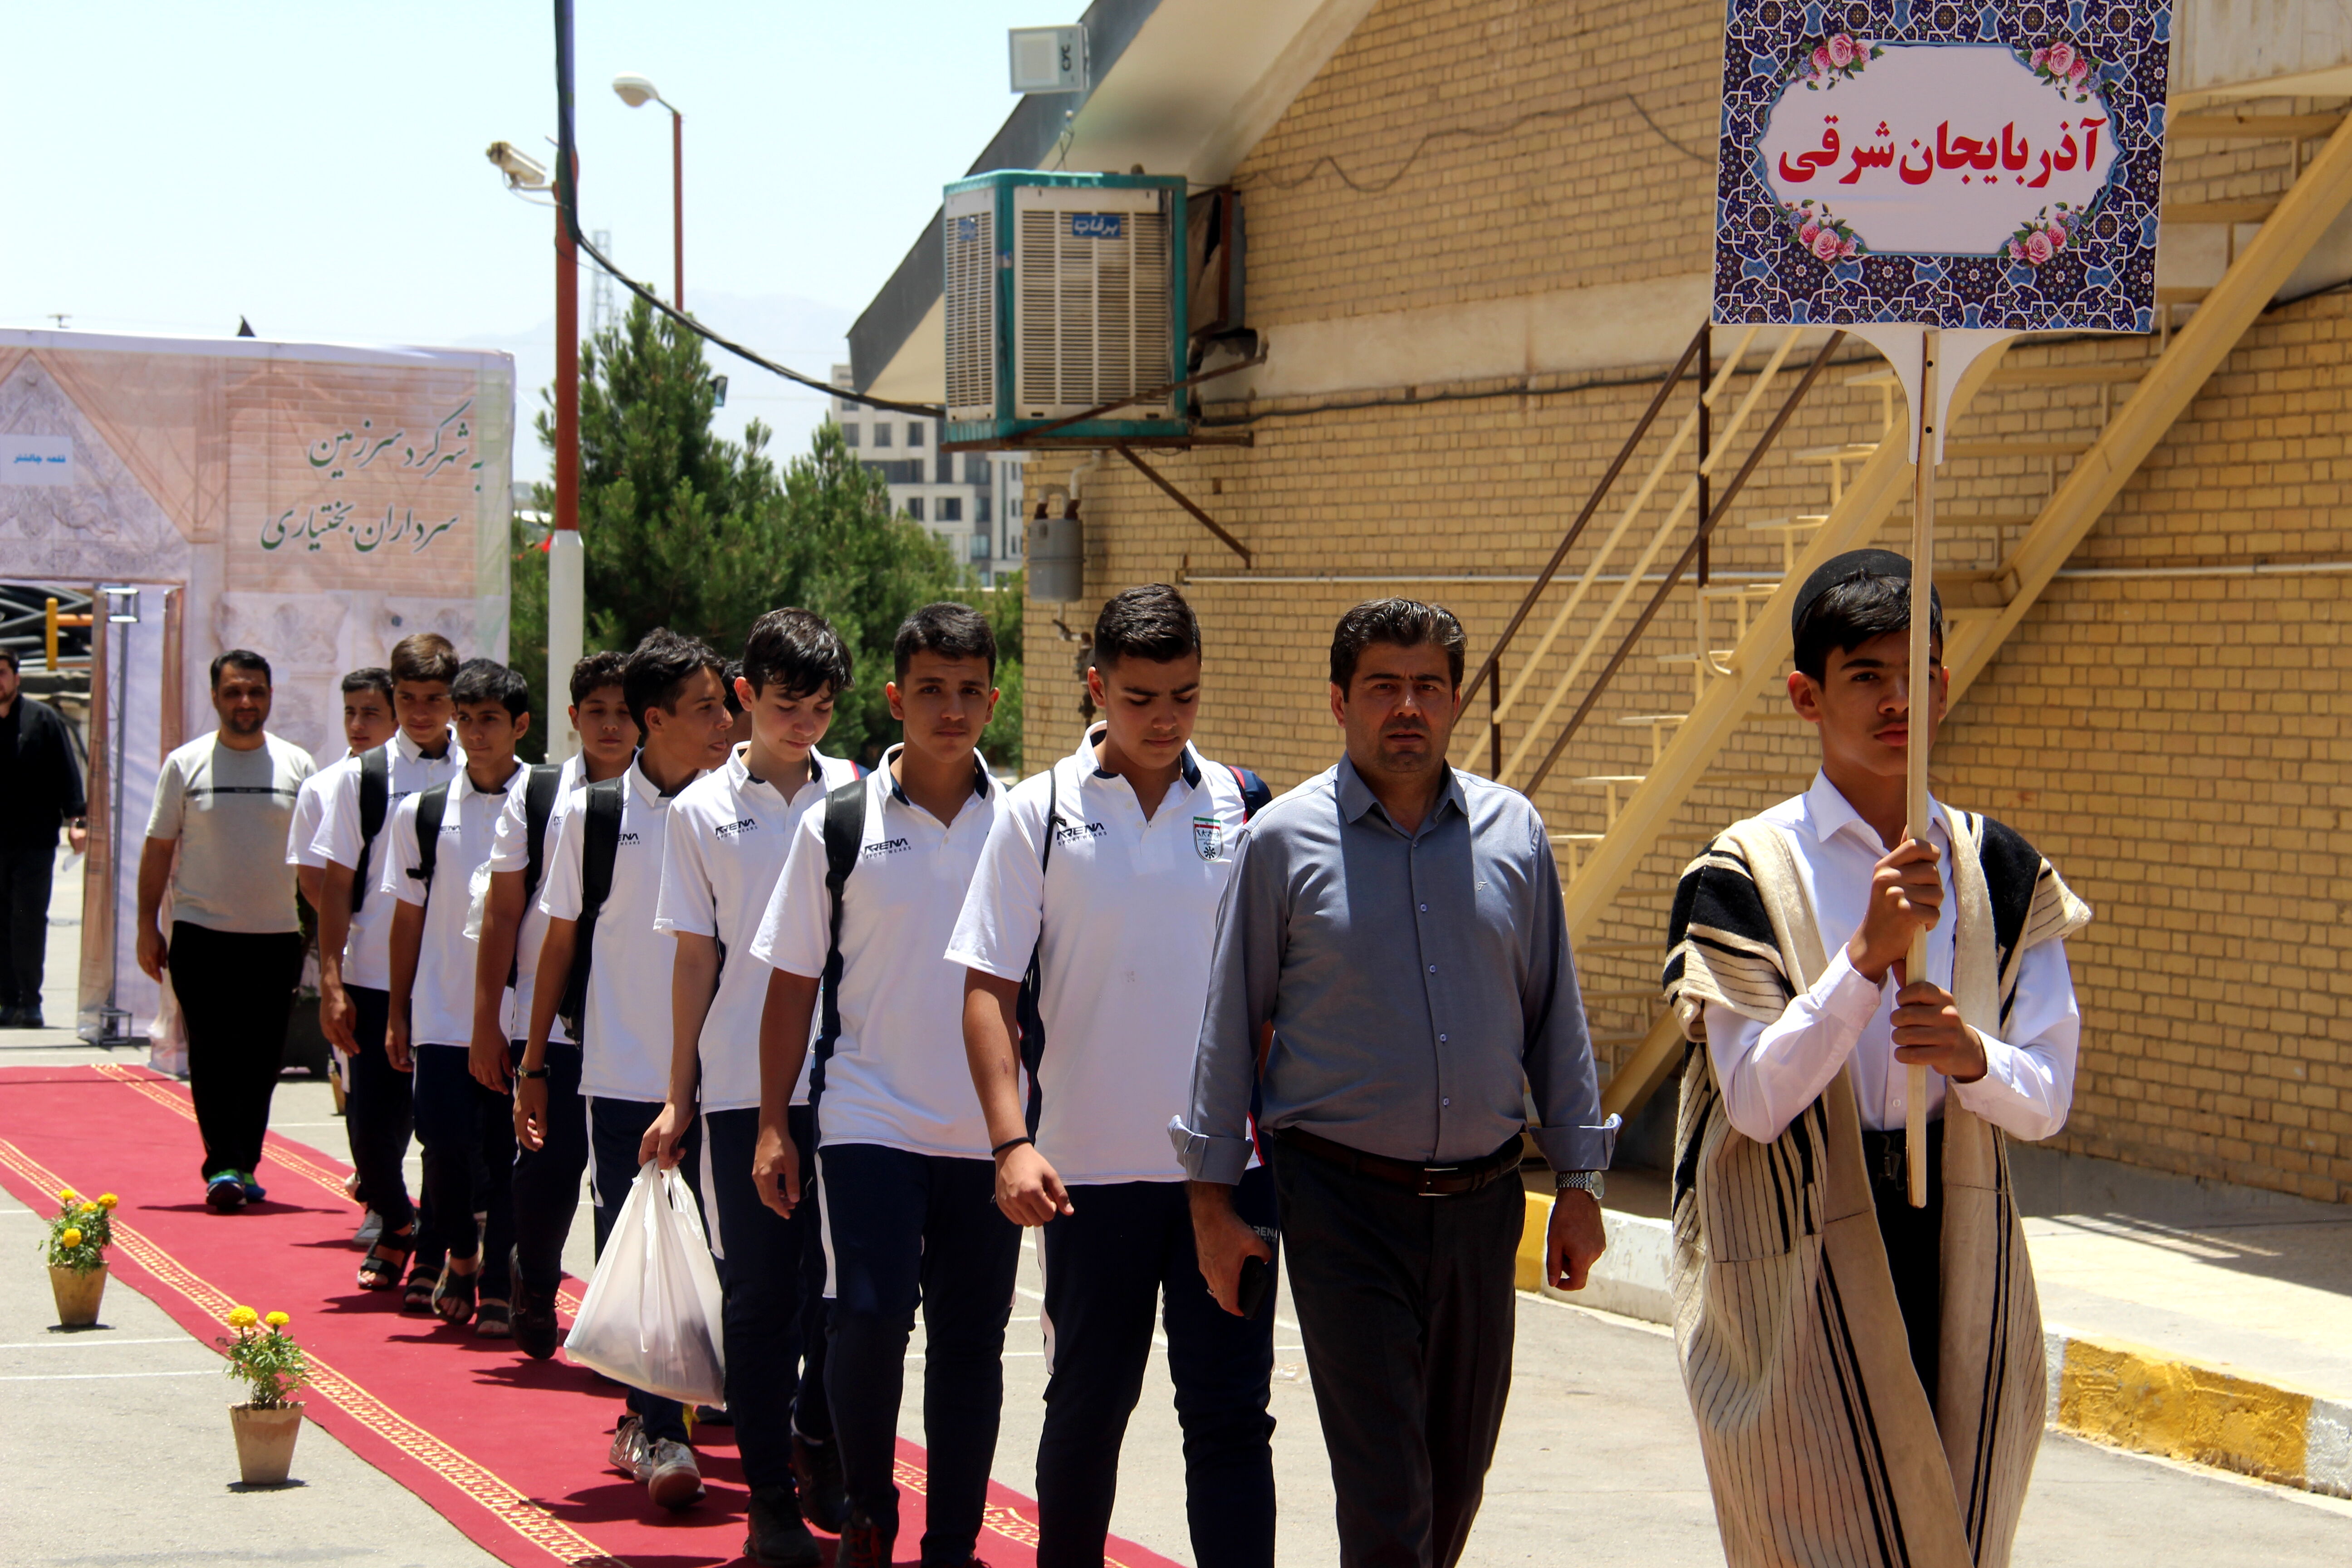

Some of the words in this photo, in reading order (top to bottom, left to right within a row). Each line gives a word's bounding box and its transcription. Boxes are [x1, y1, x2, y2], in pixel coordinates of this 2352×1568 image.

[1778, 115, 1895, 184] شرقی
[1899, 117, 2107, 188] آذربایجان
[1074, 217, 1118, 235] برفاب
[309, 419, 404, 479] سرزمین
[403, 397, 475, 478] شهرکرد
[260, 500, 356, 551] بختیاری
[354, 504, 459, 553] سرداران
[715, 818, 755, 836] ARENA
[864, 838, 908, 855] ARENA
[1057, 822, 1105, 841] ARENA
